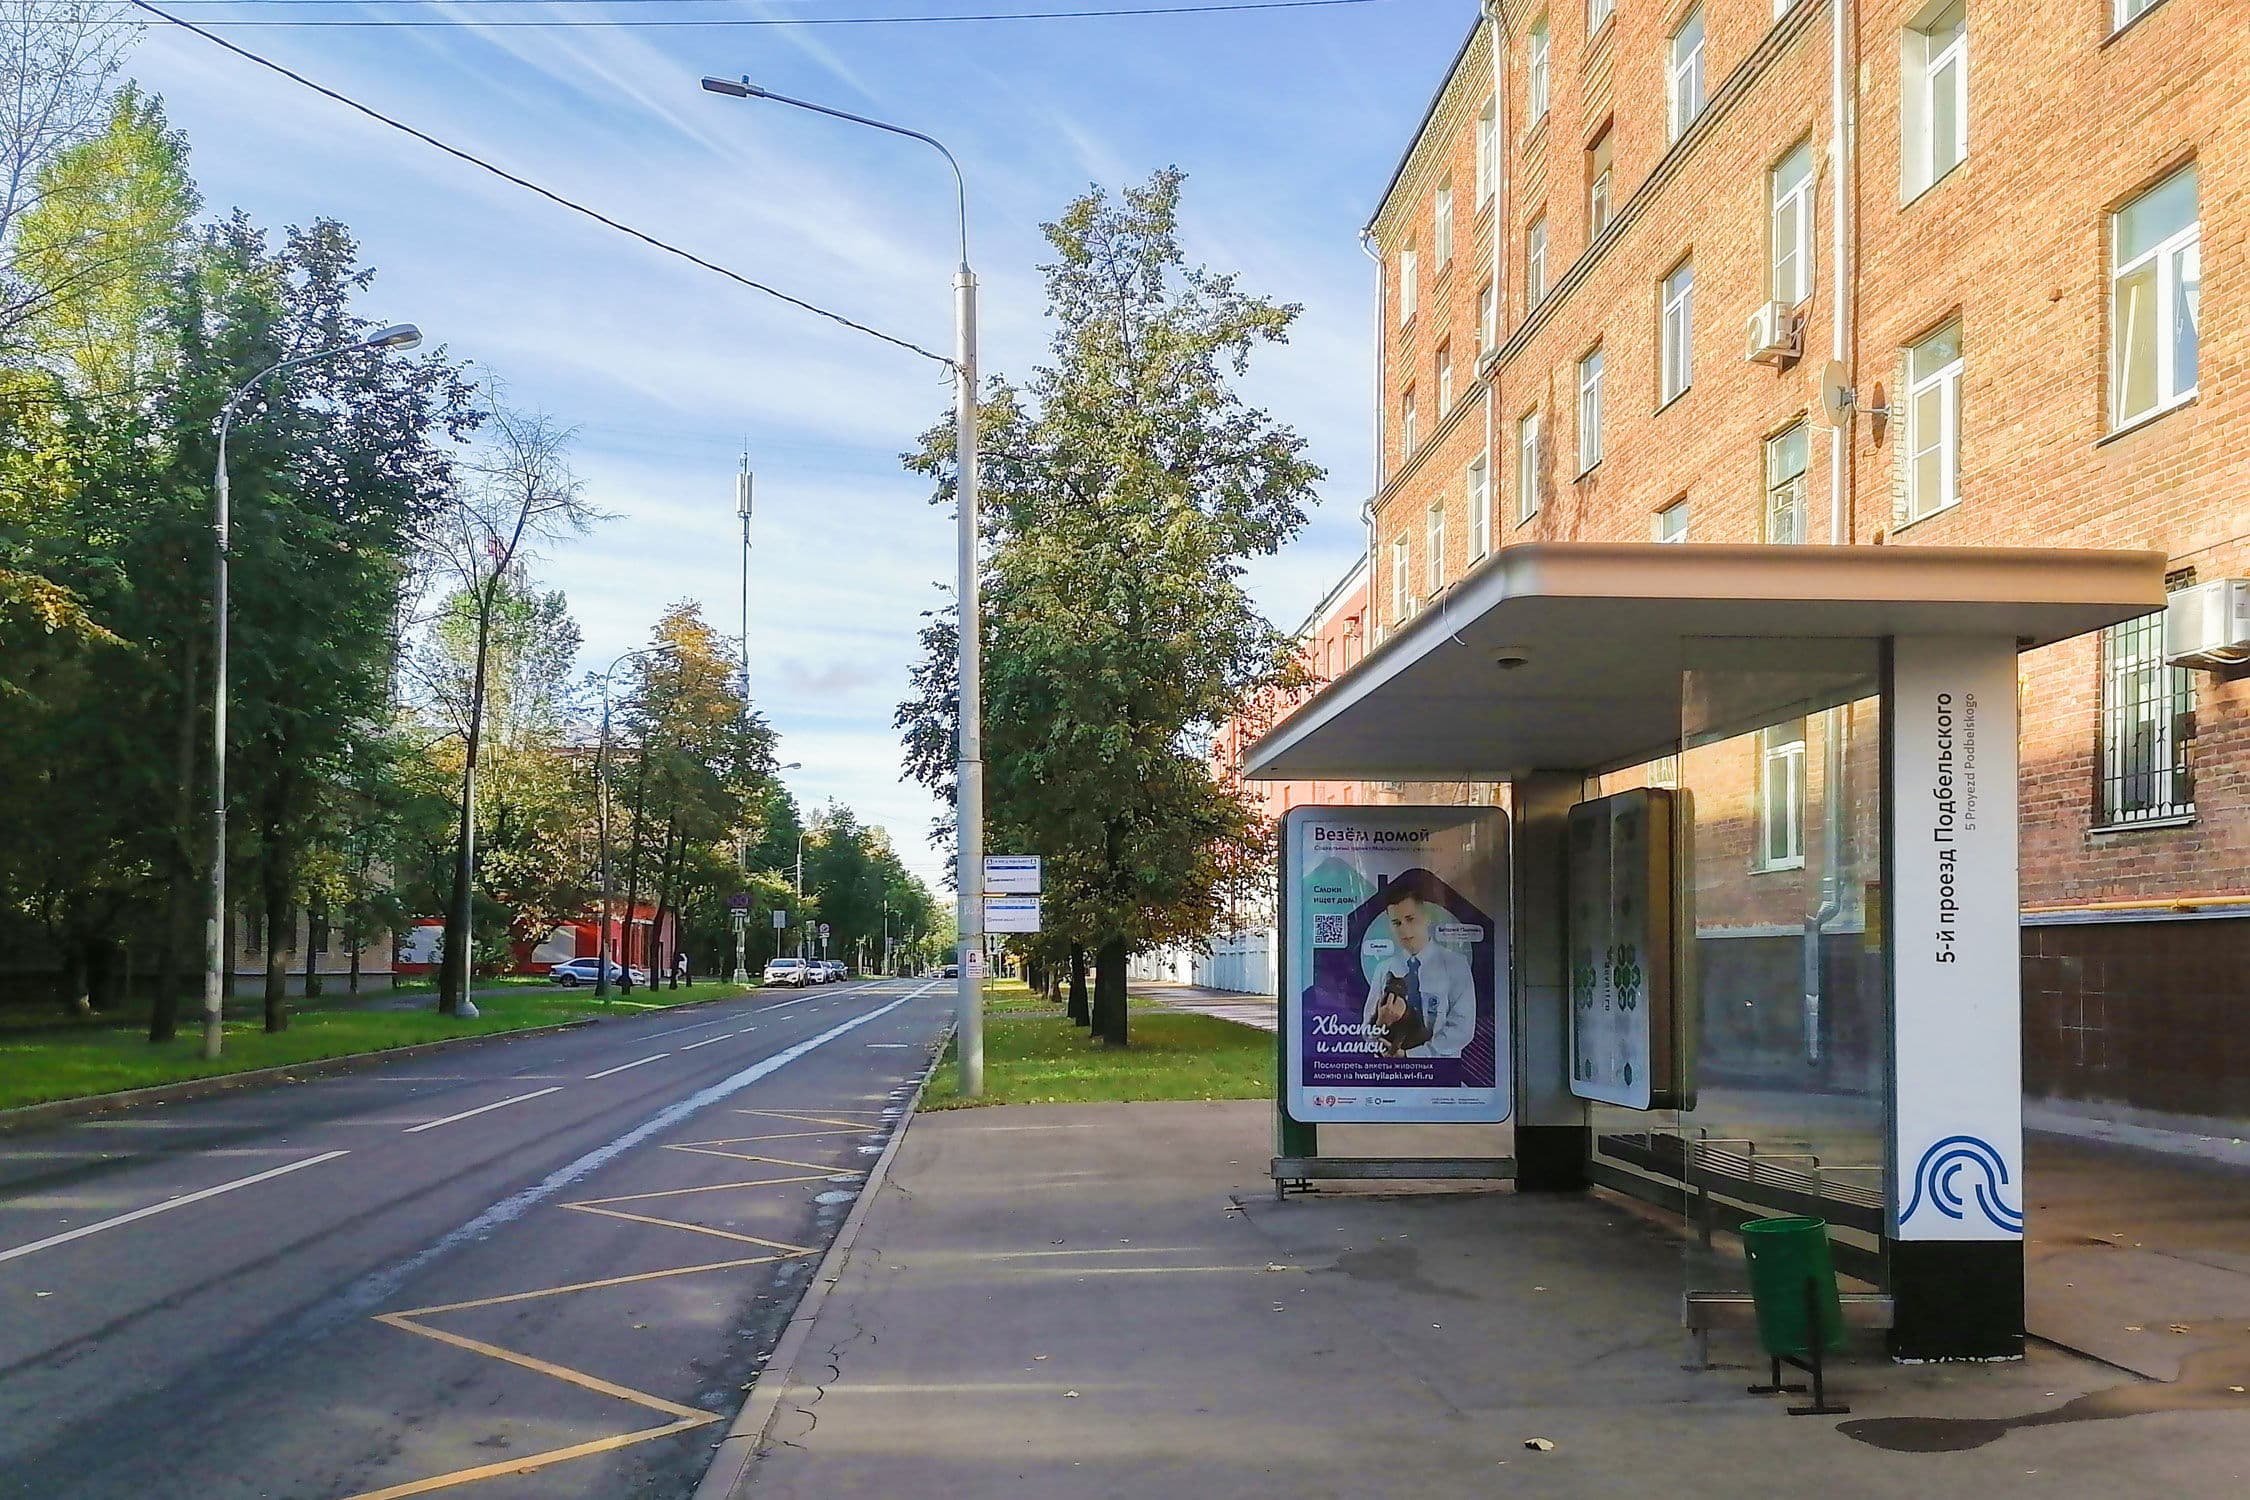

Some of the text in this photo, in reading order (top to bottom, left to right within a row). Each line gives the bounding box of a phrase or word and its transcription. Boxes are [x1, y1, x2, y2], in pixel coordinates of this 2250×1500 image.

[1964, 693, 1977, 768] Podbelskogo
[1965, 772, 1977, 820] Proyezd
[1314, 826, 1430, 844] Везём домой
[1933, 692, 1959, 963] 5-й проезд Подбельского
[1313, 885, 1342, 894] Смоки
[1313, 896, 1358, 905] ищет дом!
[1312, 1014, 1389, 1035] Хвосты
[1317, 1041, 1387, 1054] и лапки
[1314, 1061, 1434, 1071] Посмотреть анкеты животных
